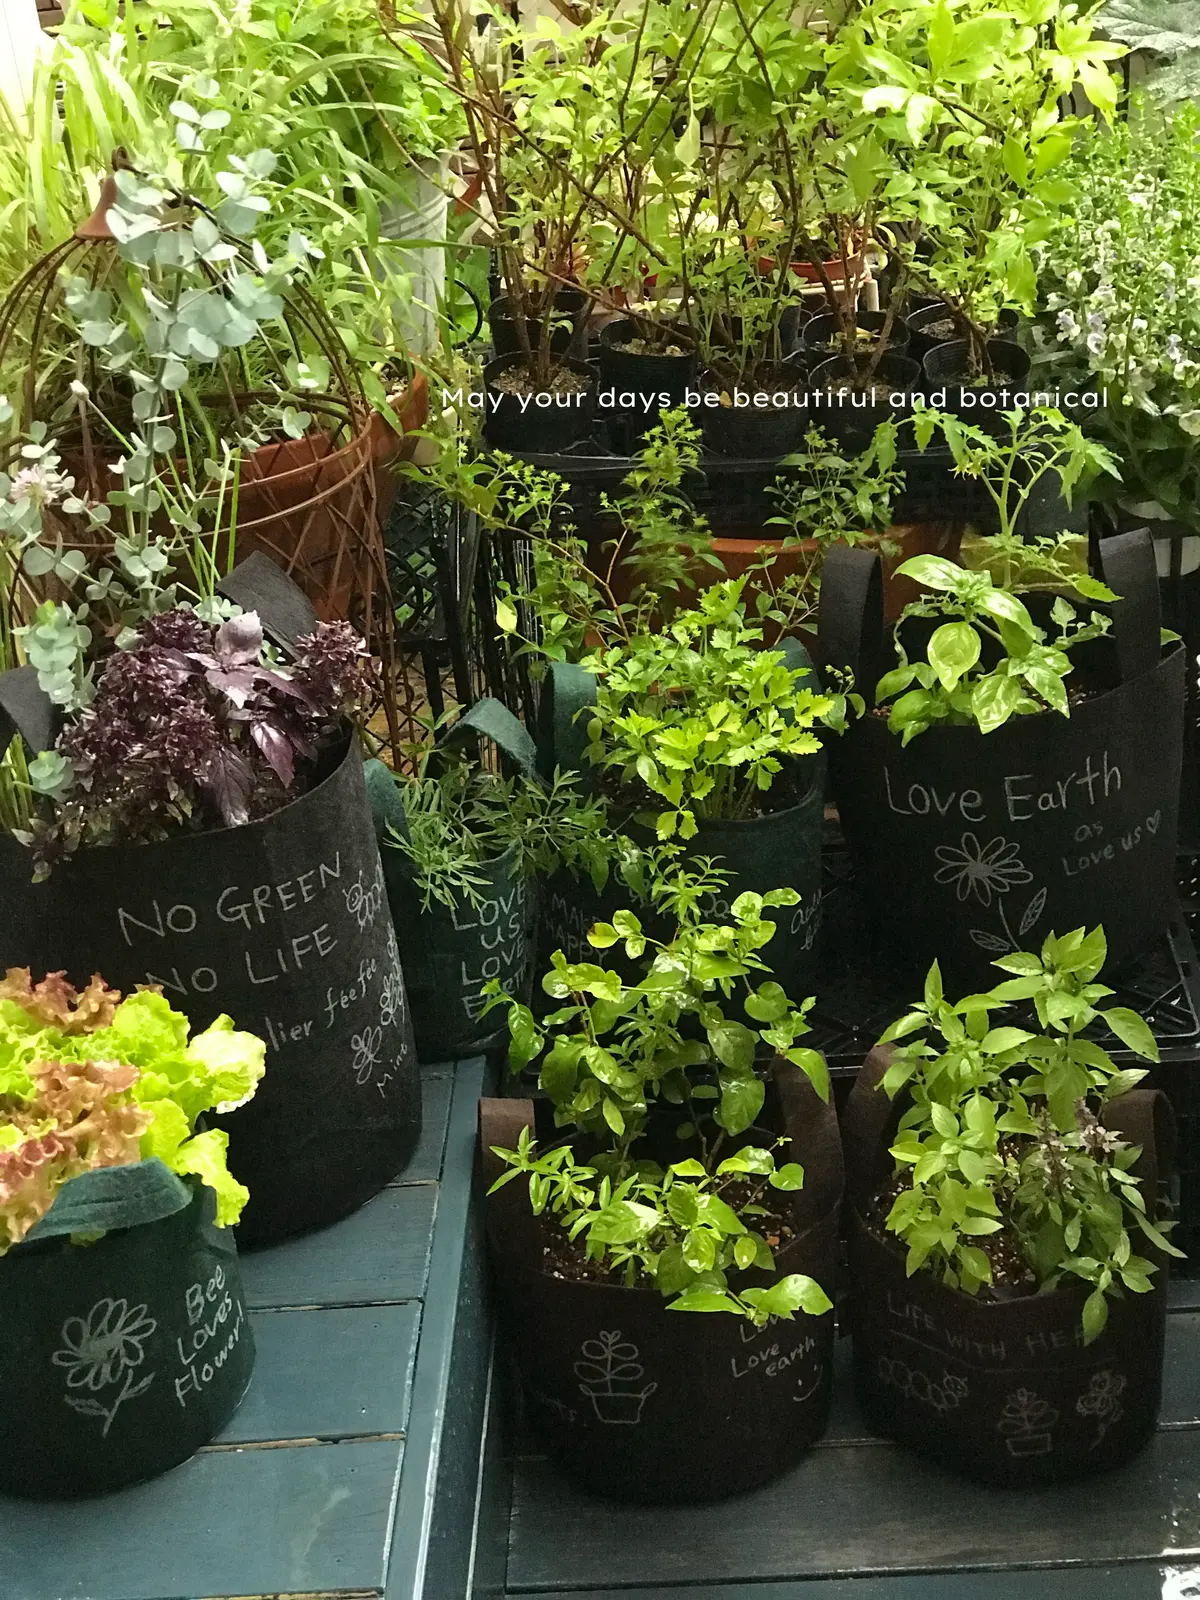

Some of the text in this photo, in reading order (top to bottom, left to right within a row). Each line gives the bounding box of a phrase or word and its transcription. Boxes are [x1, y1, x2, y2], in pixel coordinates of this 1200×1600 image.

[883, 750, 1123, 822] Love Earth
[1060, 843, 1116, 877] Love
[117, 851, 342, 947] NO GREEN
[450, 875, 528, 931] LOVE
[145, 923, 339, 996] NO LIFE
[461, 931, 527, 986] LOVE
[184, 1264, 227, 1326] Bee
[886, 1290, 937, 1331] LIFE
[177, 1290, 233, 1366] Loves
[730, 1343, 780, 1379] Love
[765, 1335, 816, 1378] earth
